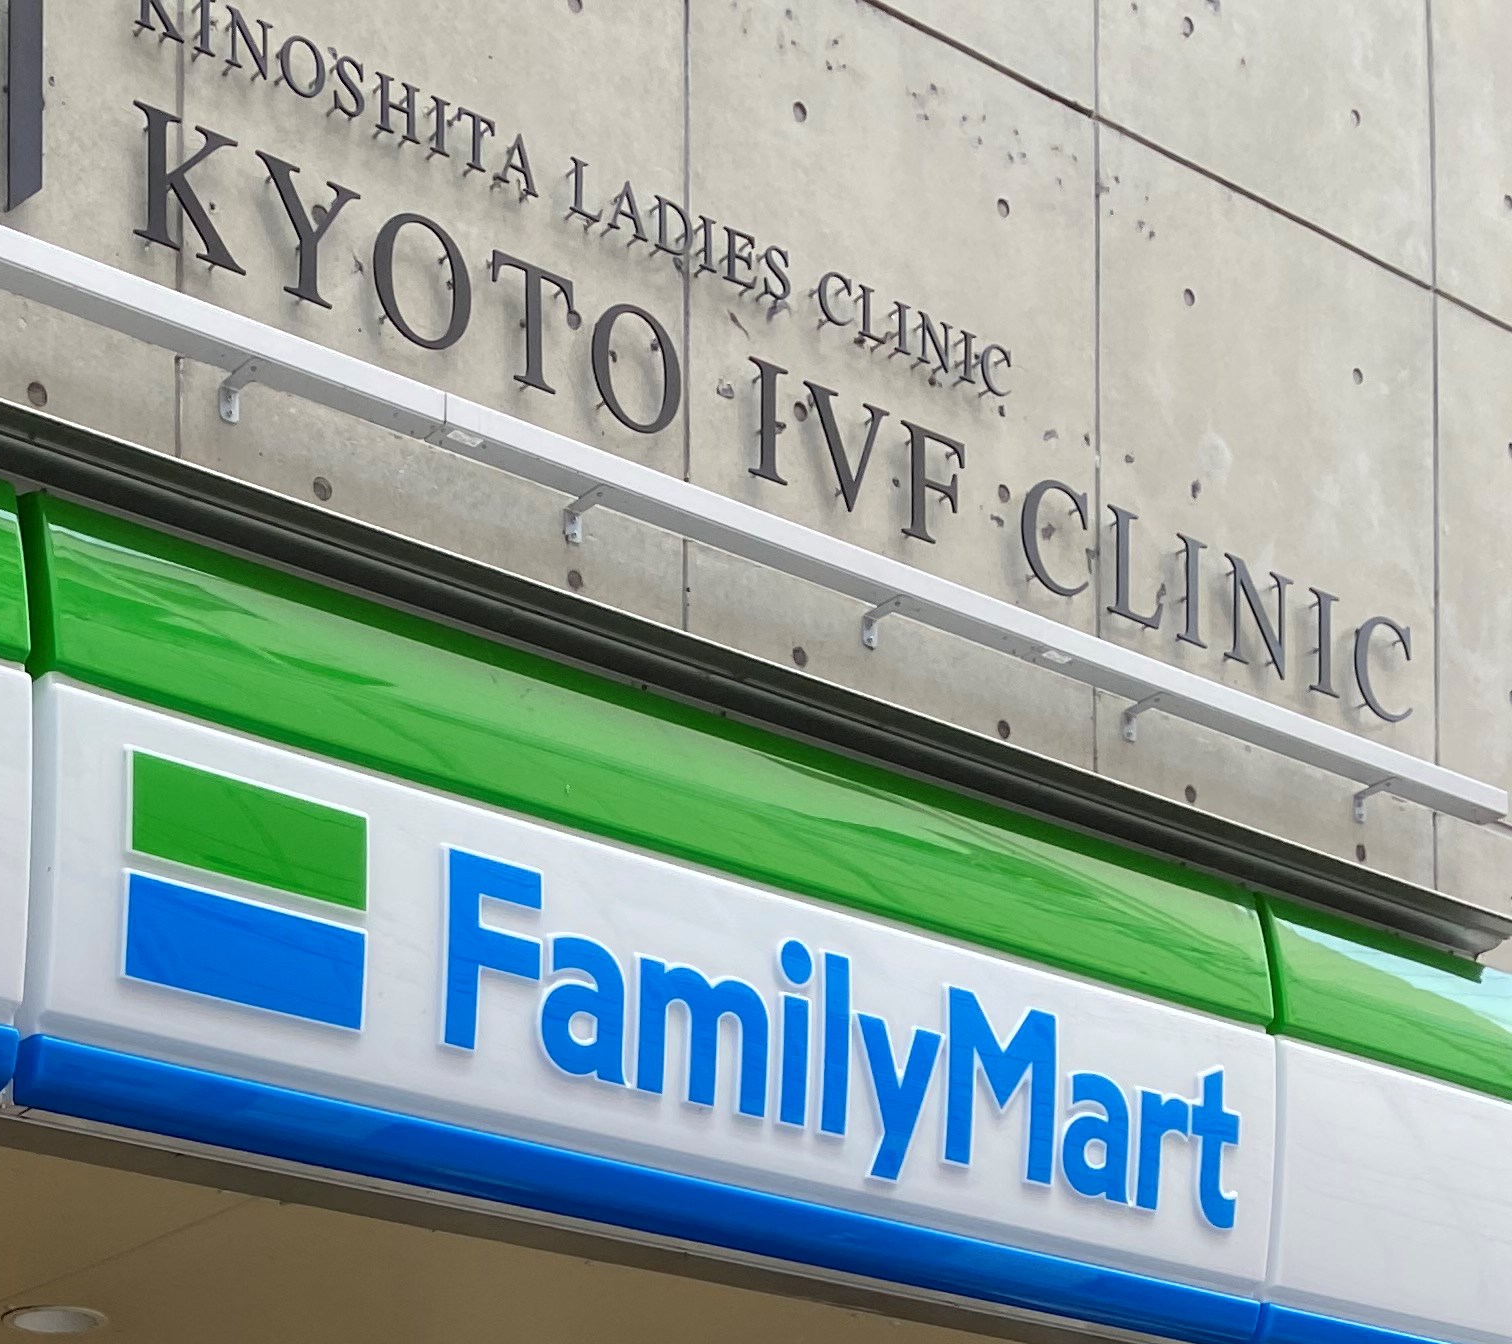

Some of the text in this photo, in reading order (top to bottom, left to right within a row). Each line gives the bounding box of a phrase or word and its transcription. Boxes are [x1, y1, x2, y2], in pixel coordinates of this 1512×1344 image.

[133, 0, 1013, 397] KINOSHITA LADIES CLINIC
[133, 99, 1415, 723] KYOTO IVF CLINIC
[441, 843, 1241, 1230] FamilyMart
